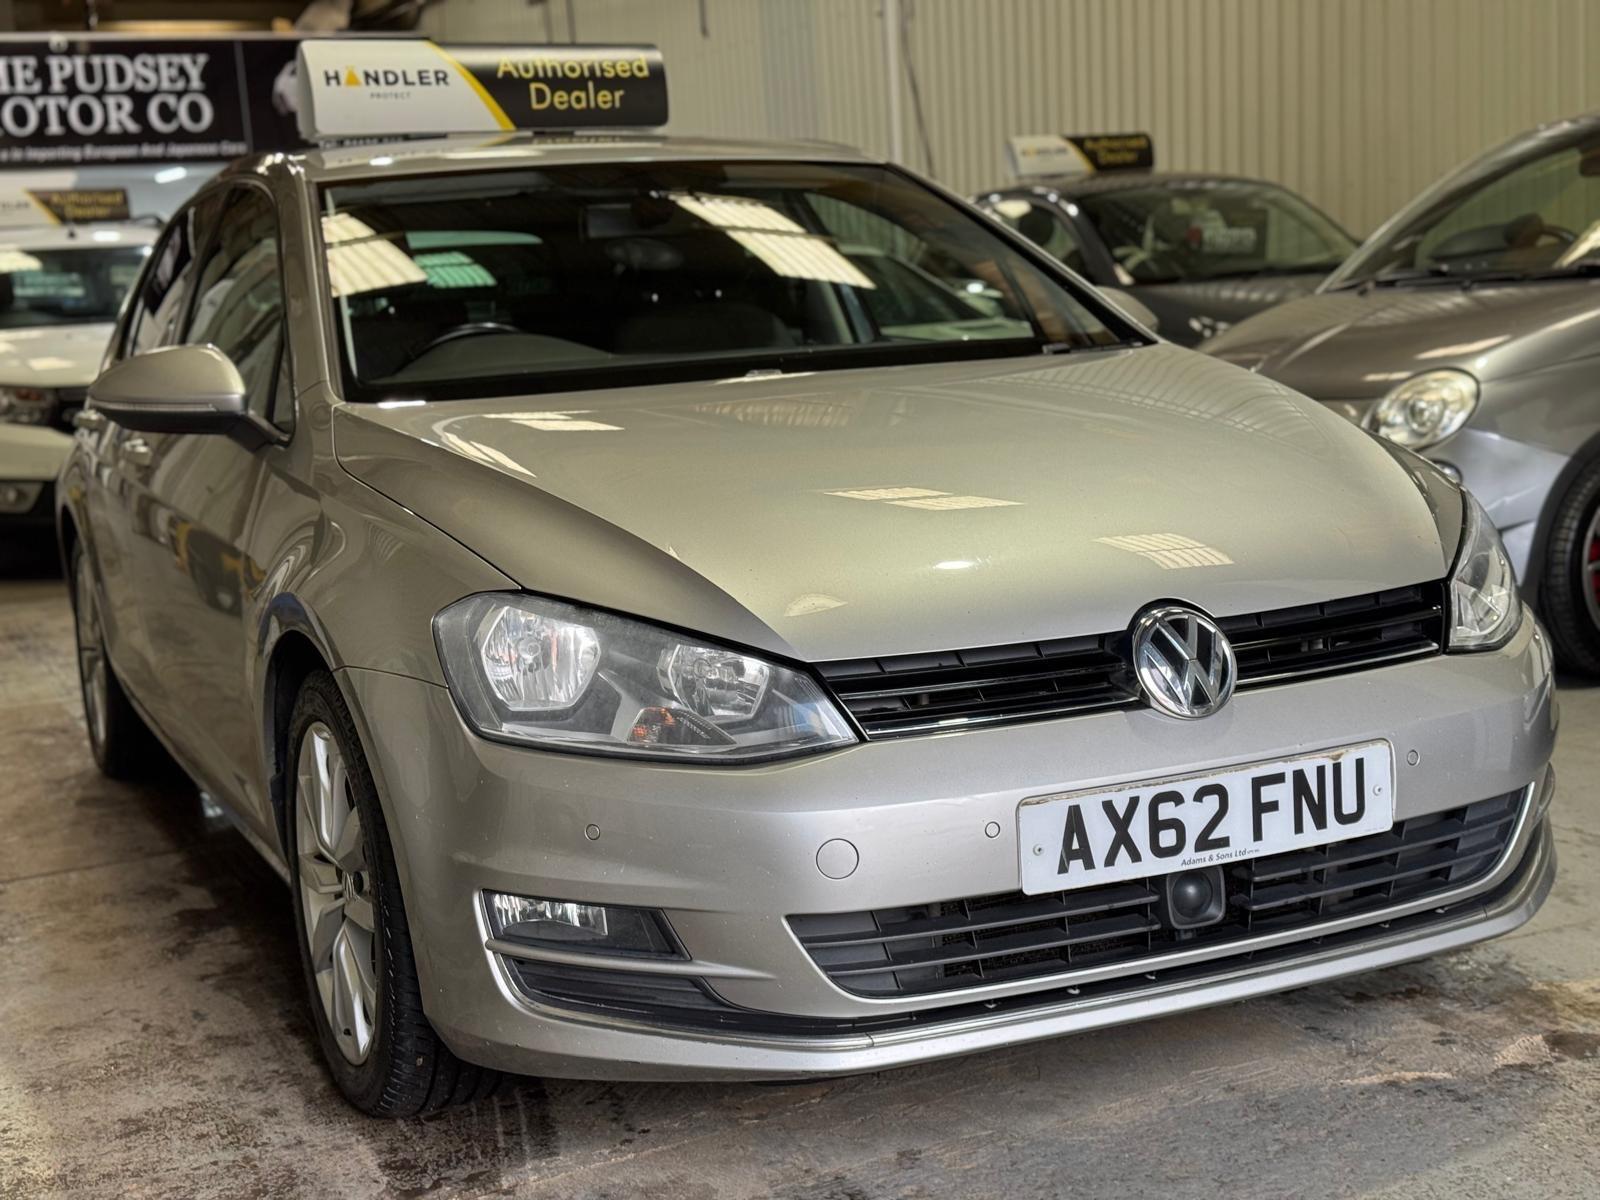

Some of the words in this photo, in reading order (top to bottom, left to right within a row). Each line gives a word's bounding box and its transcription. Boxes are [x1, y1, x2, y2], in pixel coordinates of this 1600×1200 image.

[45, 53, 210, 94] PUDSEY
[496, 54, 650, 79] Authorised
[529, 81, 625, 109] Dealer
[0, 93, 142, 138] OTOR
[146, 92, 215, 134] CO
[1057, 783, 1231, 875] AX62
[1251, 757, 1365, 842] FNU
[1181, 857, 1207, 867] Adams
[1207, 853, 1215, 862] &
[1215, 851, 1233, 861] Sons
[1234, 847, 1247, 858] Ltd
